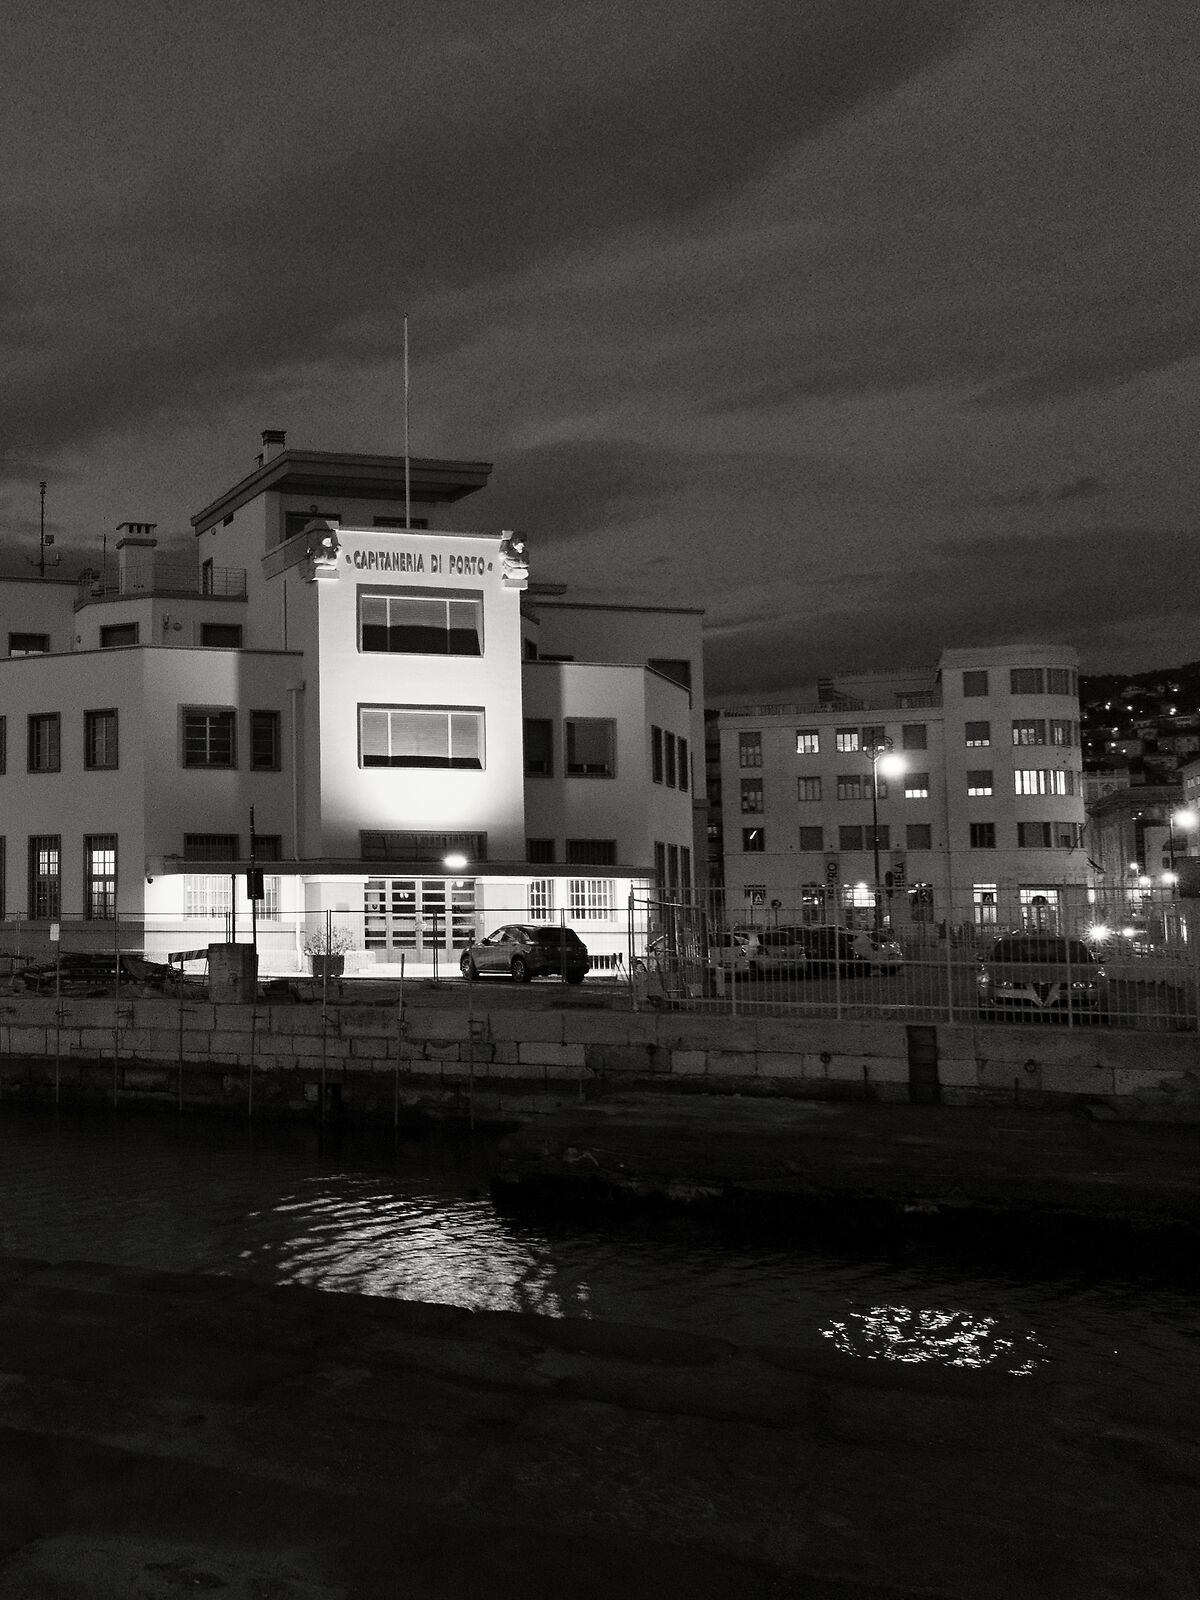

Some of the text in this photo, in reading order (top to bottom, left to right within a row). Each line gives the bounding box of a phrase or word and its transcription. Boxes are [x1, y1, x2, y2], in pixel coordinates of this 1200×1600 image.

[354, 550, 485, 576] CAPITANERIA DI PORTO
